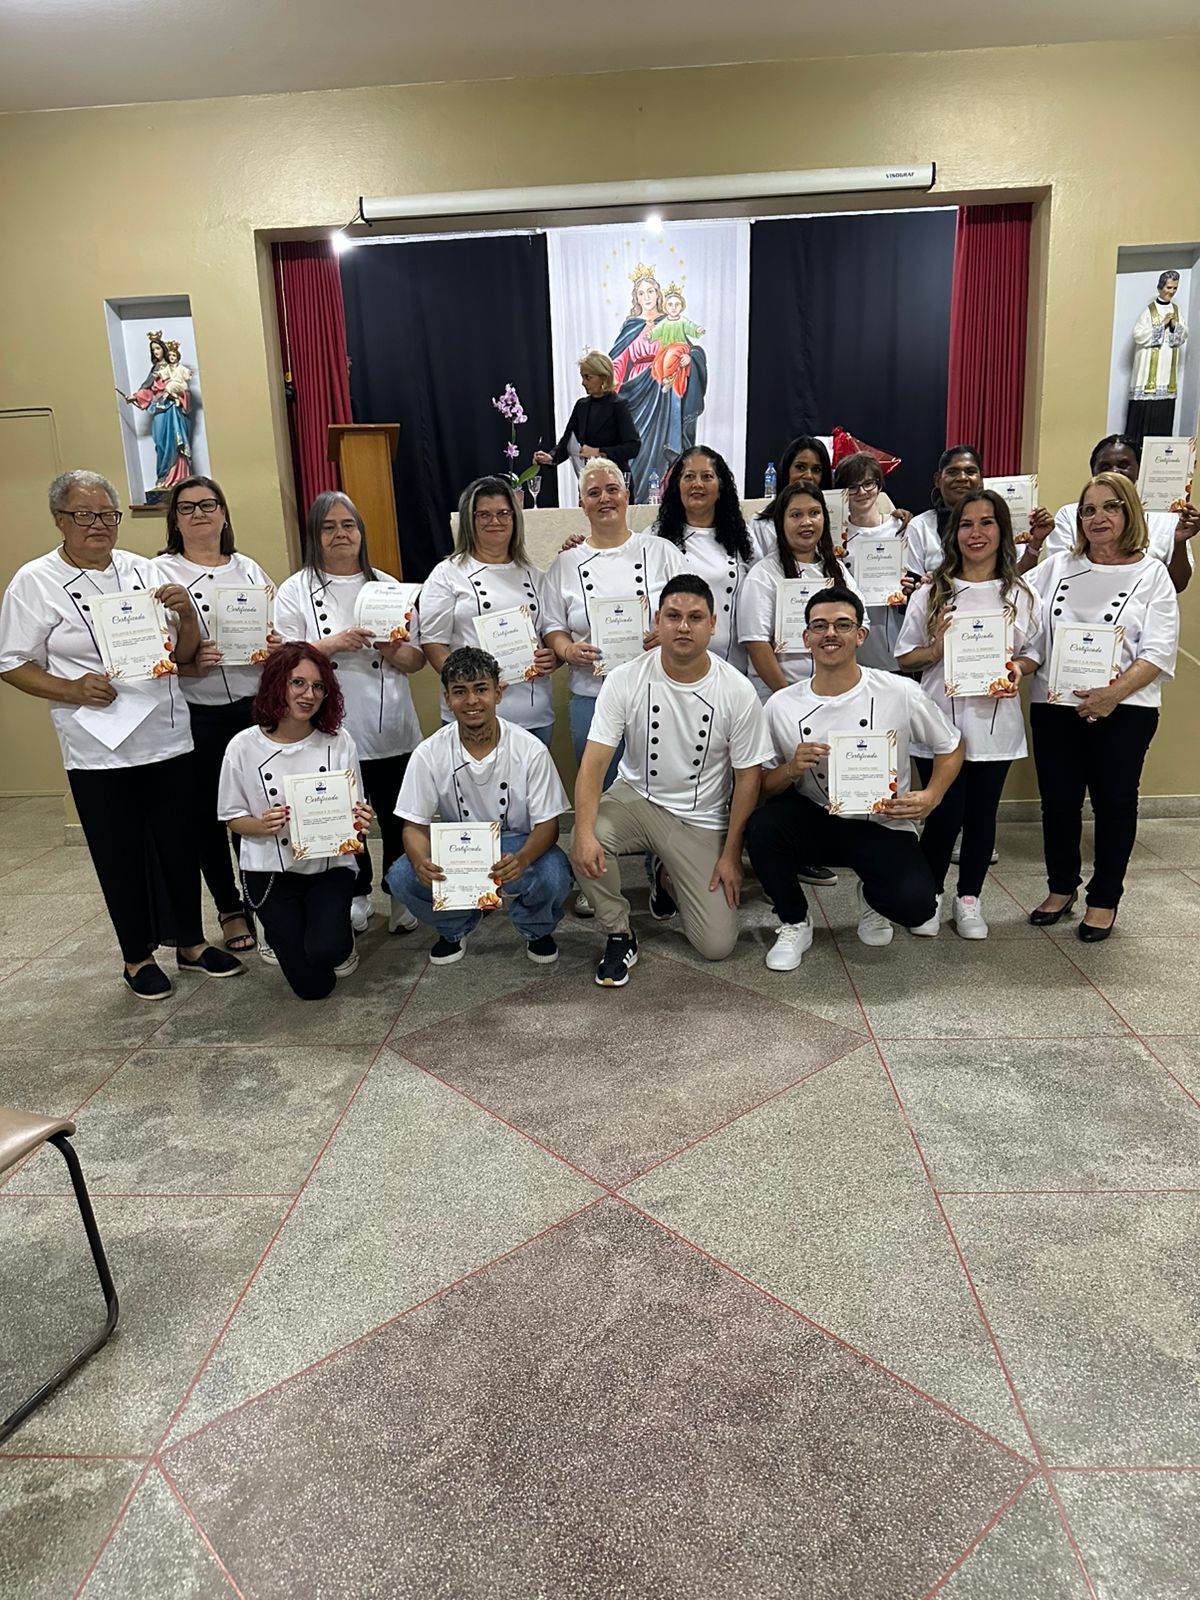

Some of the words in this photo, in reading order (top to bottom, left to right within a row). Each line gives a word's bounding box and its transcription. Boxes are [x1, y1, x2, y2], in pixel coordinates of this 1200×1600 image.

[226, 605, 257, 614] Certificado
[112, 613, 145, 624] Certificado
[605, 616, 633, 625] Certificado
[961, 632, 994, 641] Certificado
[1069, 643, 1102, 654] Certificado
[846, 751, 878, 760] Certificado
[304, 794, 339, 804] Certificado
[449, 844, 482, 853] Certificado
